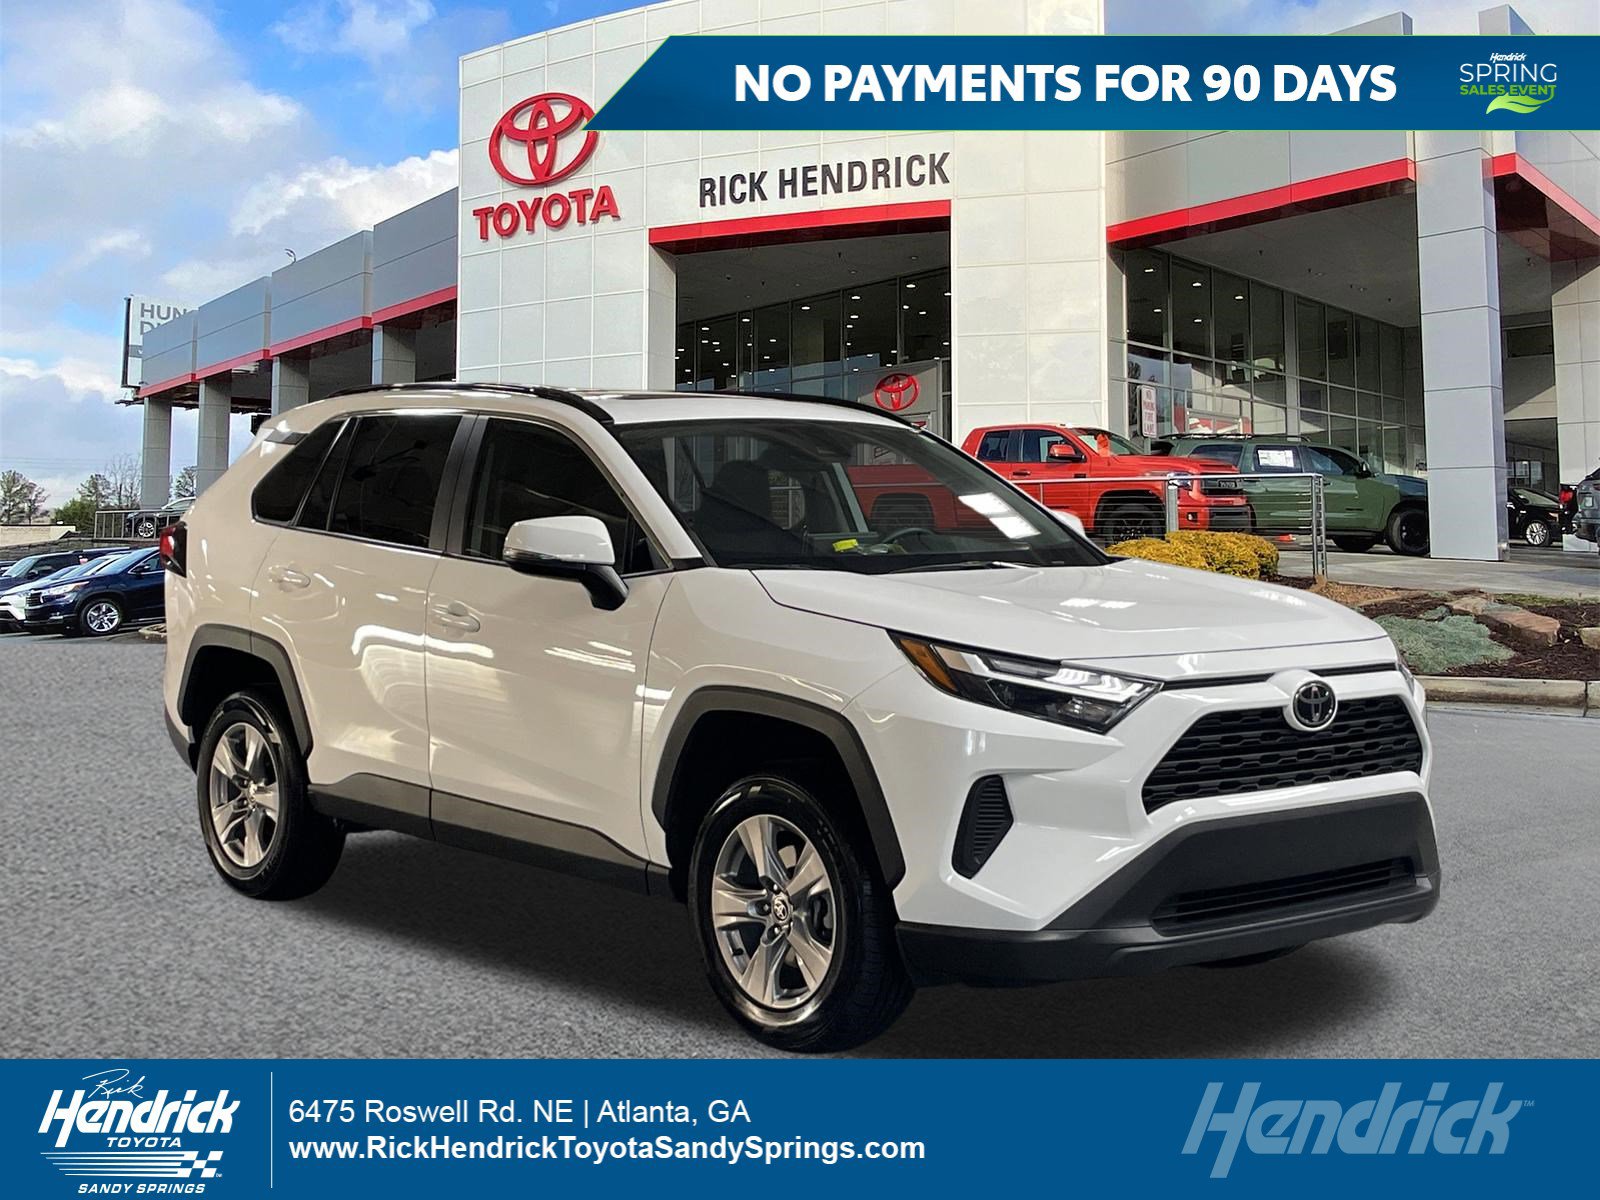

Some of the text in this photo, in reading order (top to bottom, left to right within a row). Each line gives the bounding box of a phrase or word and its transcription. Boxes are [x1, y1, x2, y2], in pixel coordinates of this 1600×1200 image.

[698, 151, 951, 208] RICK HENDRICK
[472, 184, 621, 241] TOYOTA
